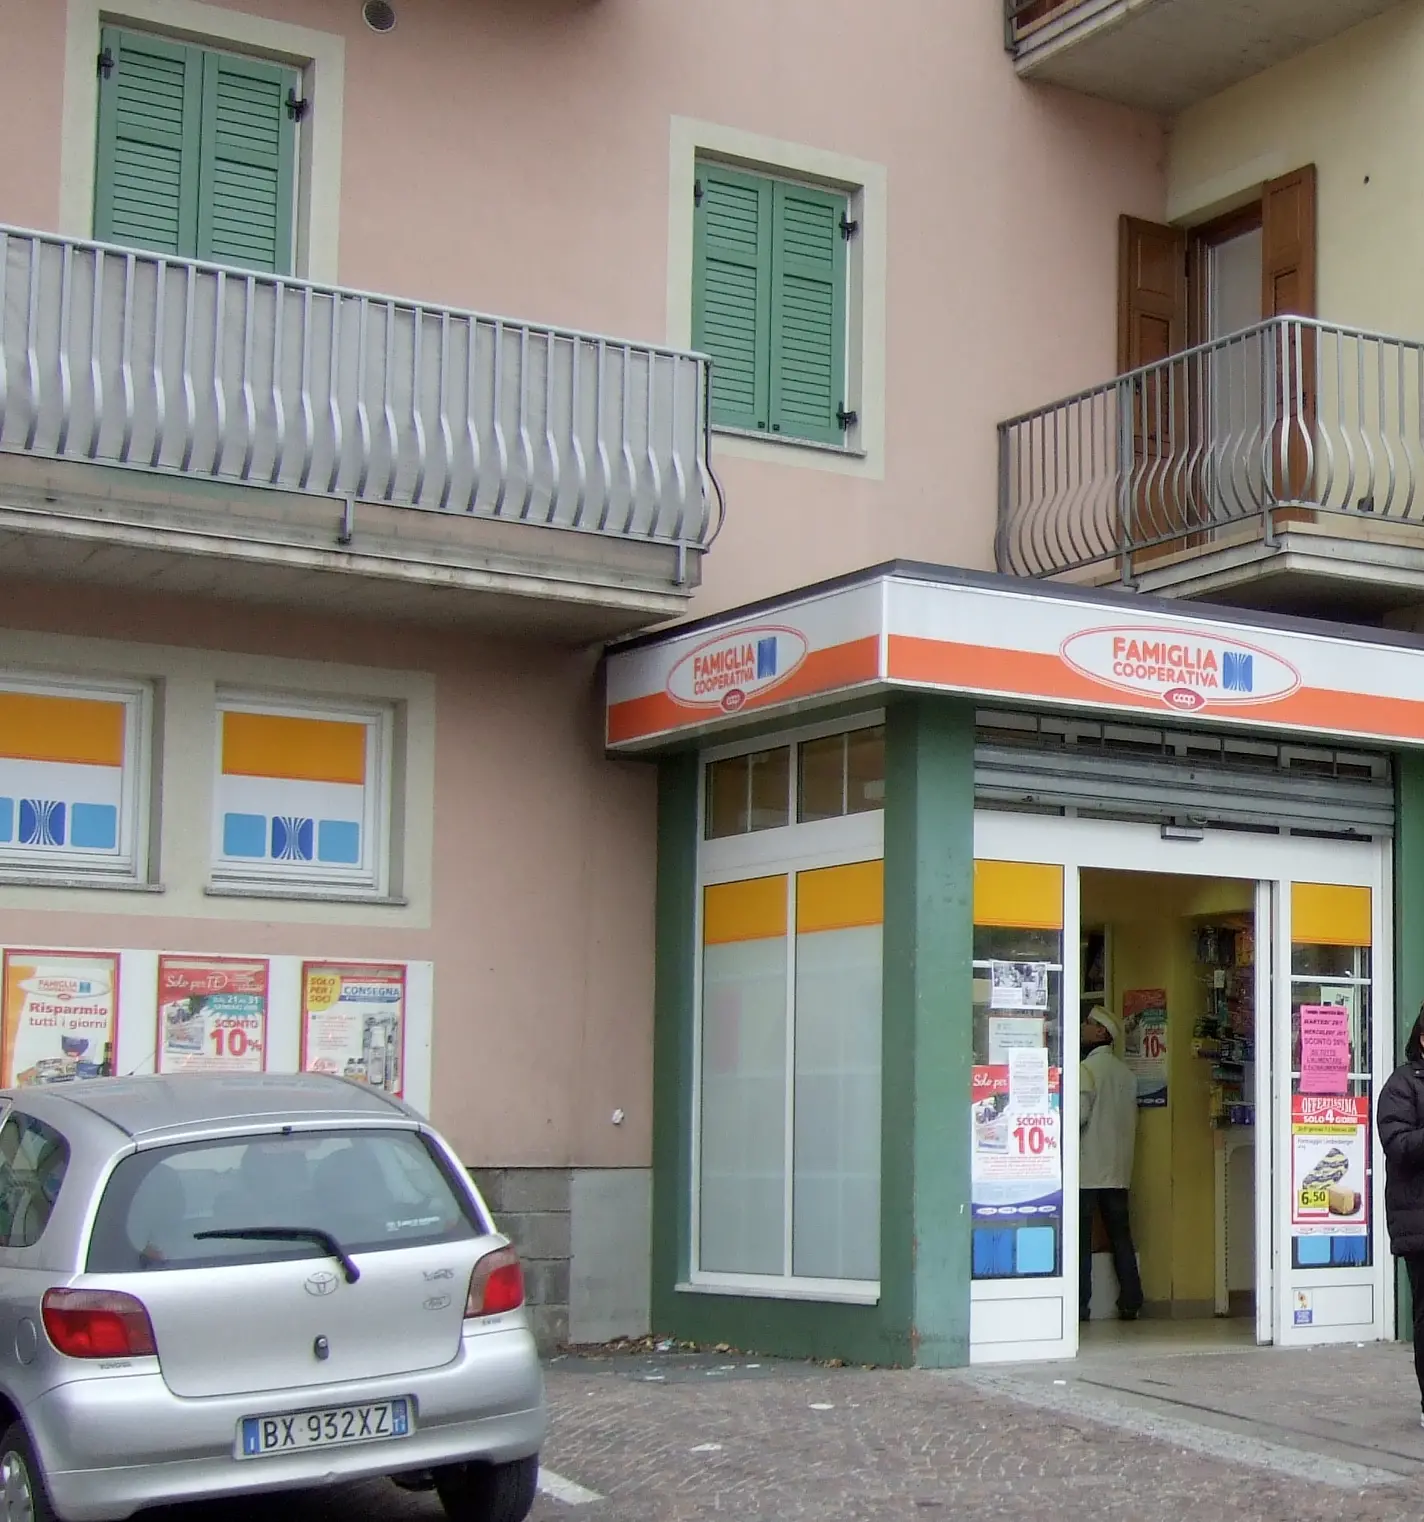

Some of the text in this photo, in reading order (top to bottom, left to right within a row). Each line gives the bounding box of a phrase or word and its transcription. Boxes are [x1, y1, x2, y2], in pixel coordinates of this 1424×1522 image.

[1112, 636, 1218, 672] FAMIGLIA
[693, 643, 755, 680] FAMIGLIA
[693, 667, 755, 695] COOPERATIVA
[1112, 660, 1218, 688] COOPERATIVA
[1172, 693, 1196, 706] coop
[311, 977, 335, 986] SOLO
[344, 986, 400, 996] CONSEGNA
[29, 1002, 107, 1016] Risparmio
[29, 1017, 57, 1026] tutti
[69, 1019, 107, 1029] giorni
[215, 1019, 258, 1028] SCONTO
[209, 1028, 262, 1056] 10%
[973, 1074, 992, 1088] Solo
[1302, 1097, 1357, 1116] OFFERTISSIMA
[1016, 1117, 1054, 1126] SCONTO
[1303, 1115, 1324, 1123] SOLO
[1325, 1109, 1334, 1123] 4
[1012, 1126, 1057, 1154] 10%
[263, 1417, 296, 1448] BX
[307, 1406, 390, 1442] 932XZ
